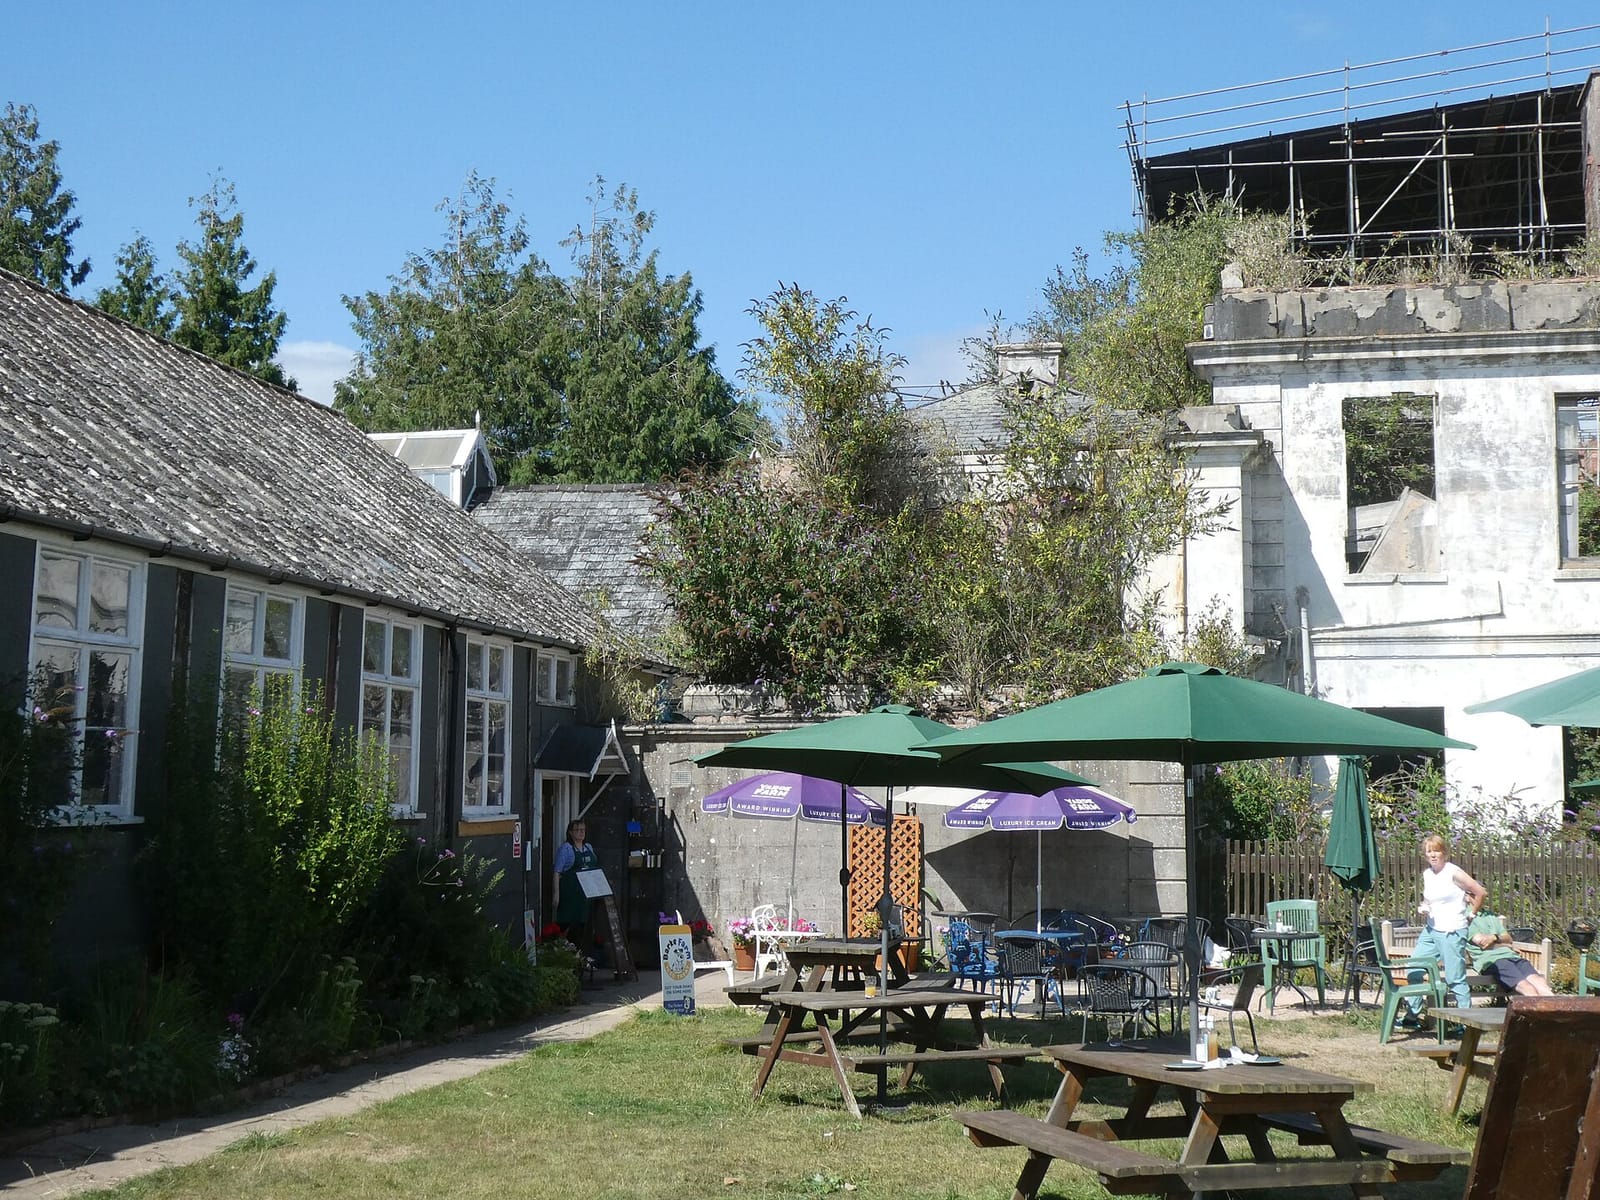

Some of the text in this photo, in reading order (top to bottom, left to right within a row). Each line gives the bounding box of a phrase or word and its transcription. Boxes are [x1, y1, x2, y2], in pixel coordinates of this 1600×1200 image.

[753, 788, 790, 797] FARM
[763, 806, 791, 814] WINNING
[1069, 803, 1102, 811] FARM
[678, 938, 691, 960] Farm
